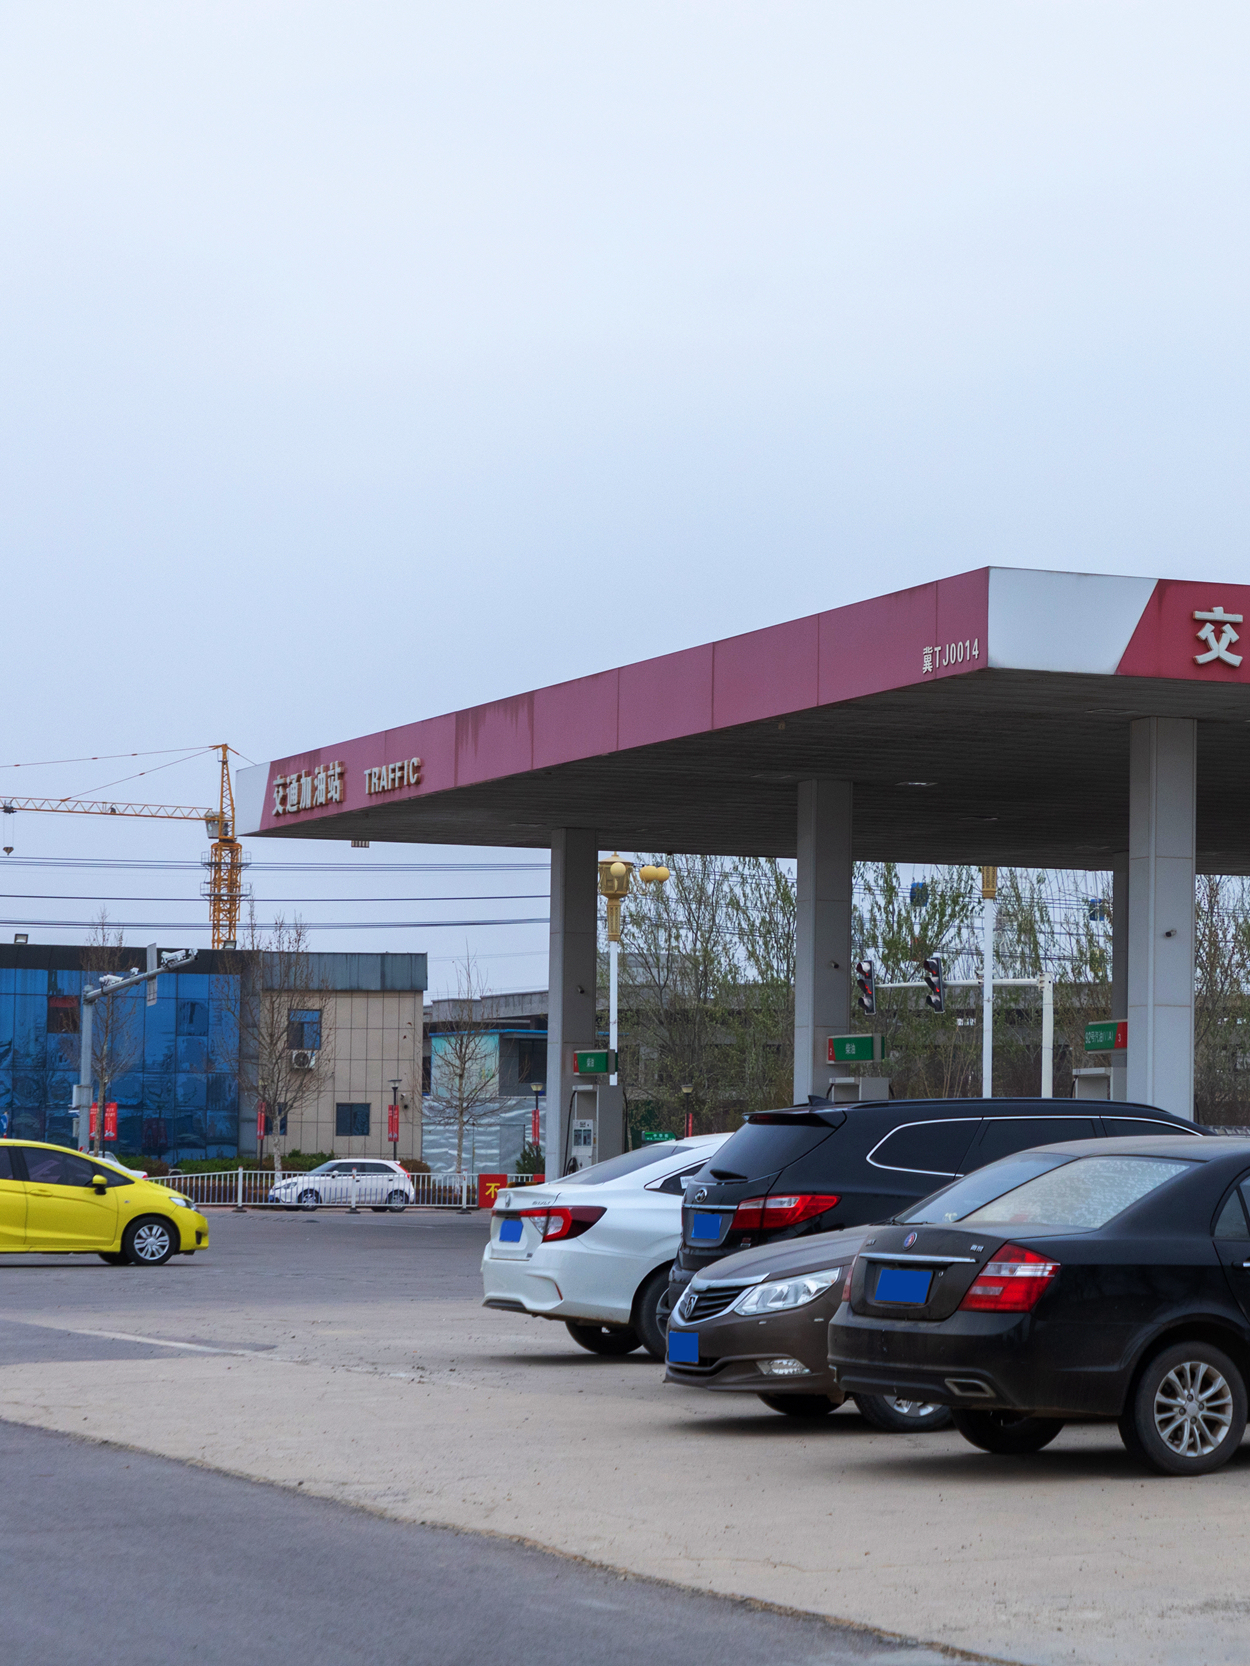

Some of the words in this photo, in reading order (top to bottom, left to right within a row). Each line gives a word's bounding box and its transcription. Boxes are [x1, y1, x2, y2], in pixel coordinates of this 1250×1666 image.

[922, 637, 980, 675] 冀TJ0014
[272, 761, 346, 817] 交通加油站
[363, 757, 422, 796] TRAFFIC
[1117, 1033, 1122, 1043] 3
[485, 1182, 498, 1199] 不
